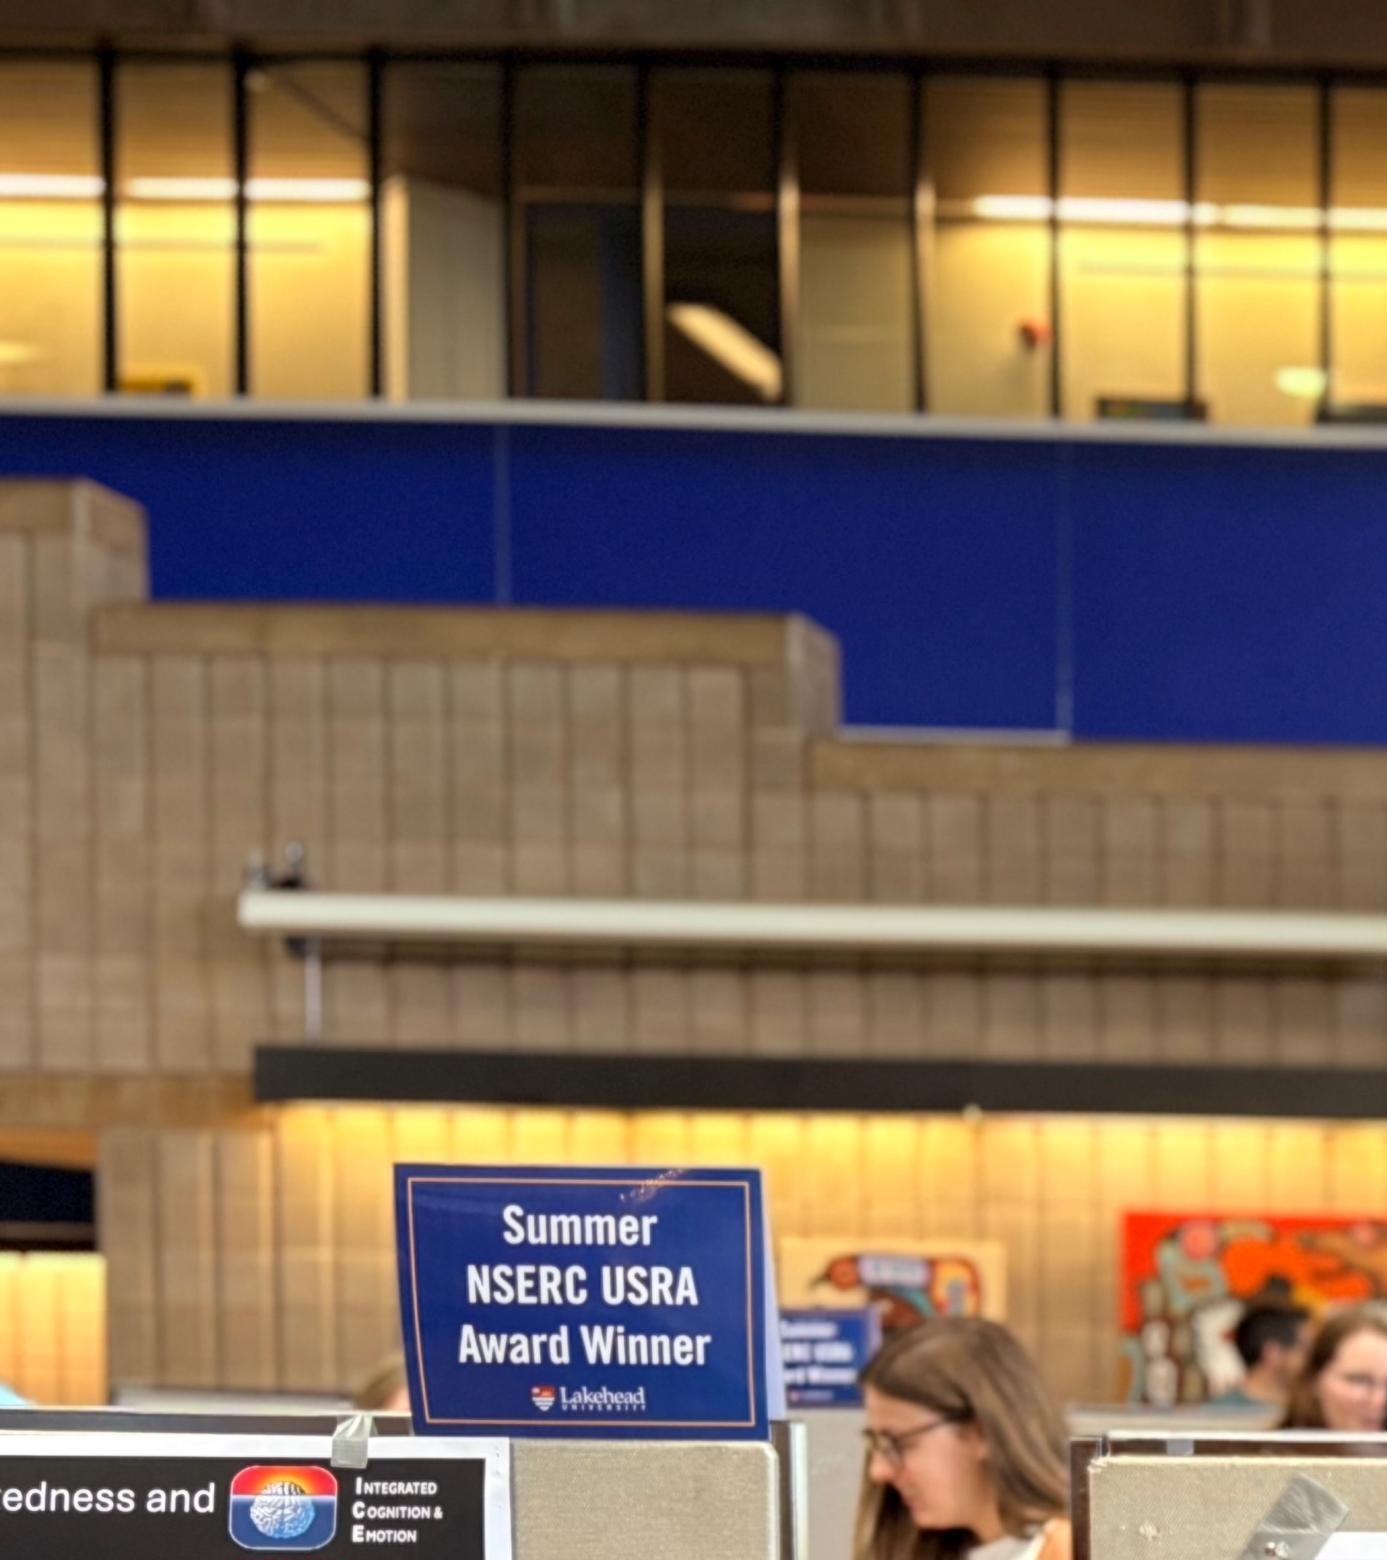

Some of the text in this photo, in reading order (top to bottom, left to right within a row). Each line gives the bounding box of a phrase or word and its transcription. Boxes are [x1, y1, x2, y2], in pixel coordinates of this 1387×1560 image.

[502, 1203, 658, 1246] Summer
[466, 1263, 698, 1306] NSERC USRA
[458, 1323, 712, 1366] Award Winner
[559, 1386, 646, 1405] Lakehead
[145, 1481, 216, 1514] and
[354, 1476, 438, 1496] INTEGRATED
[351, 1501, 444, 1520] COGNITION &
[352, 1525, 417, 1544] EMOTION
